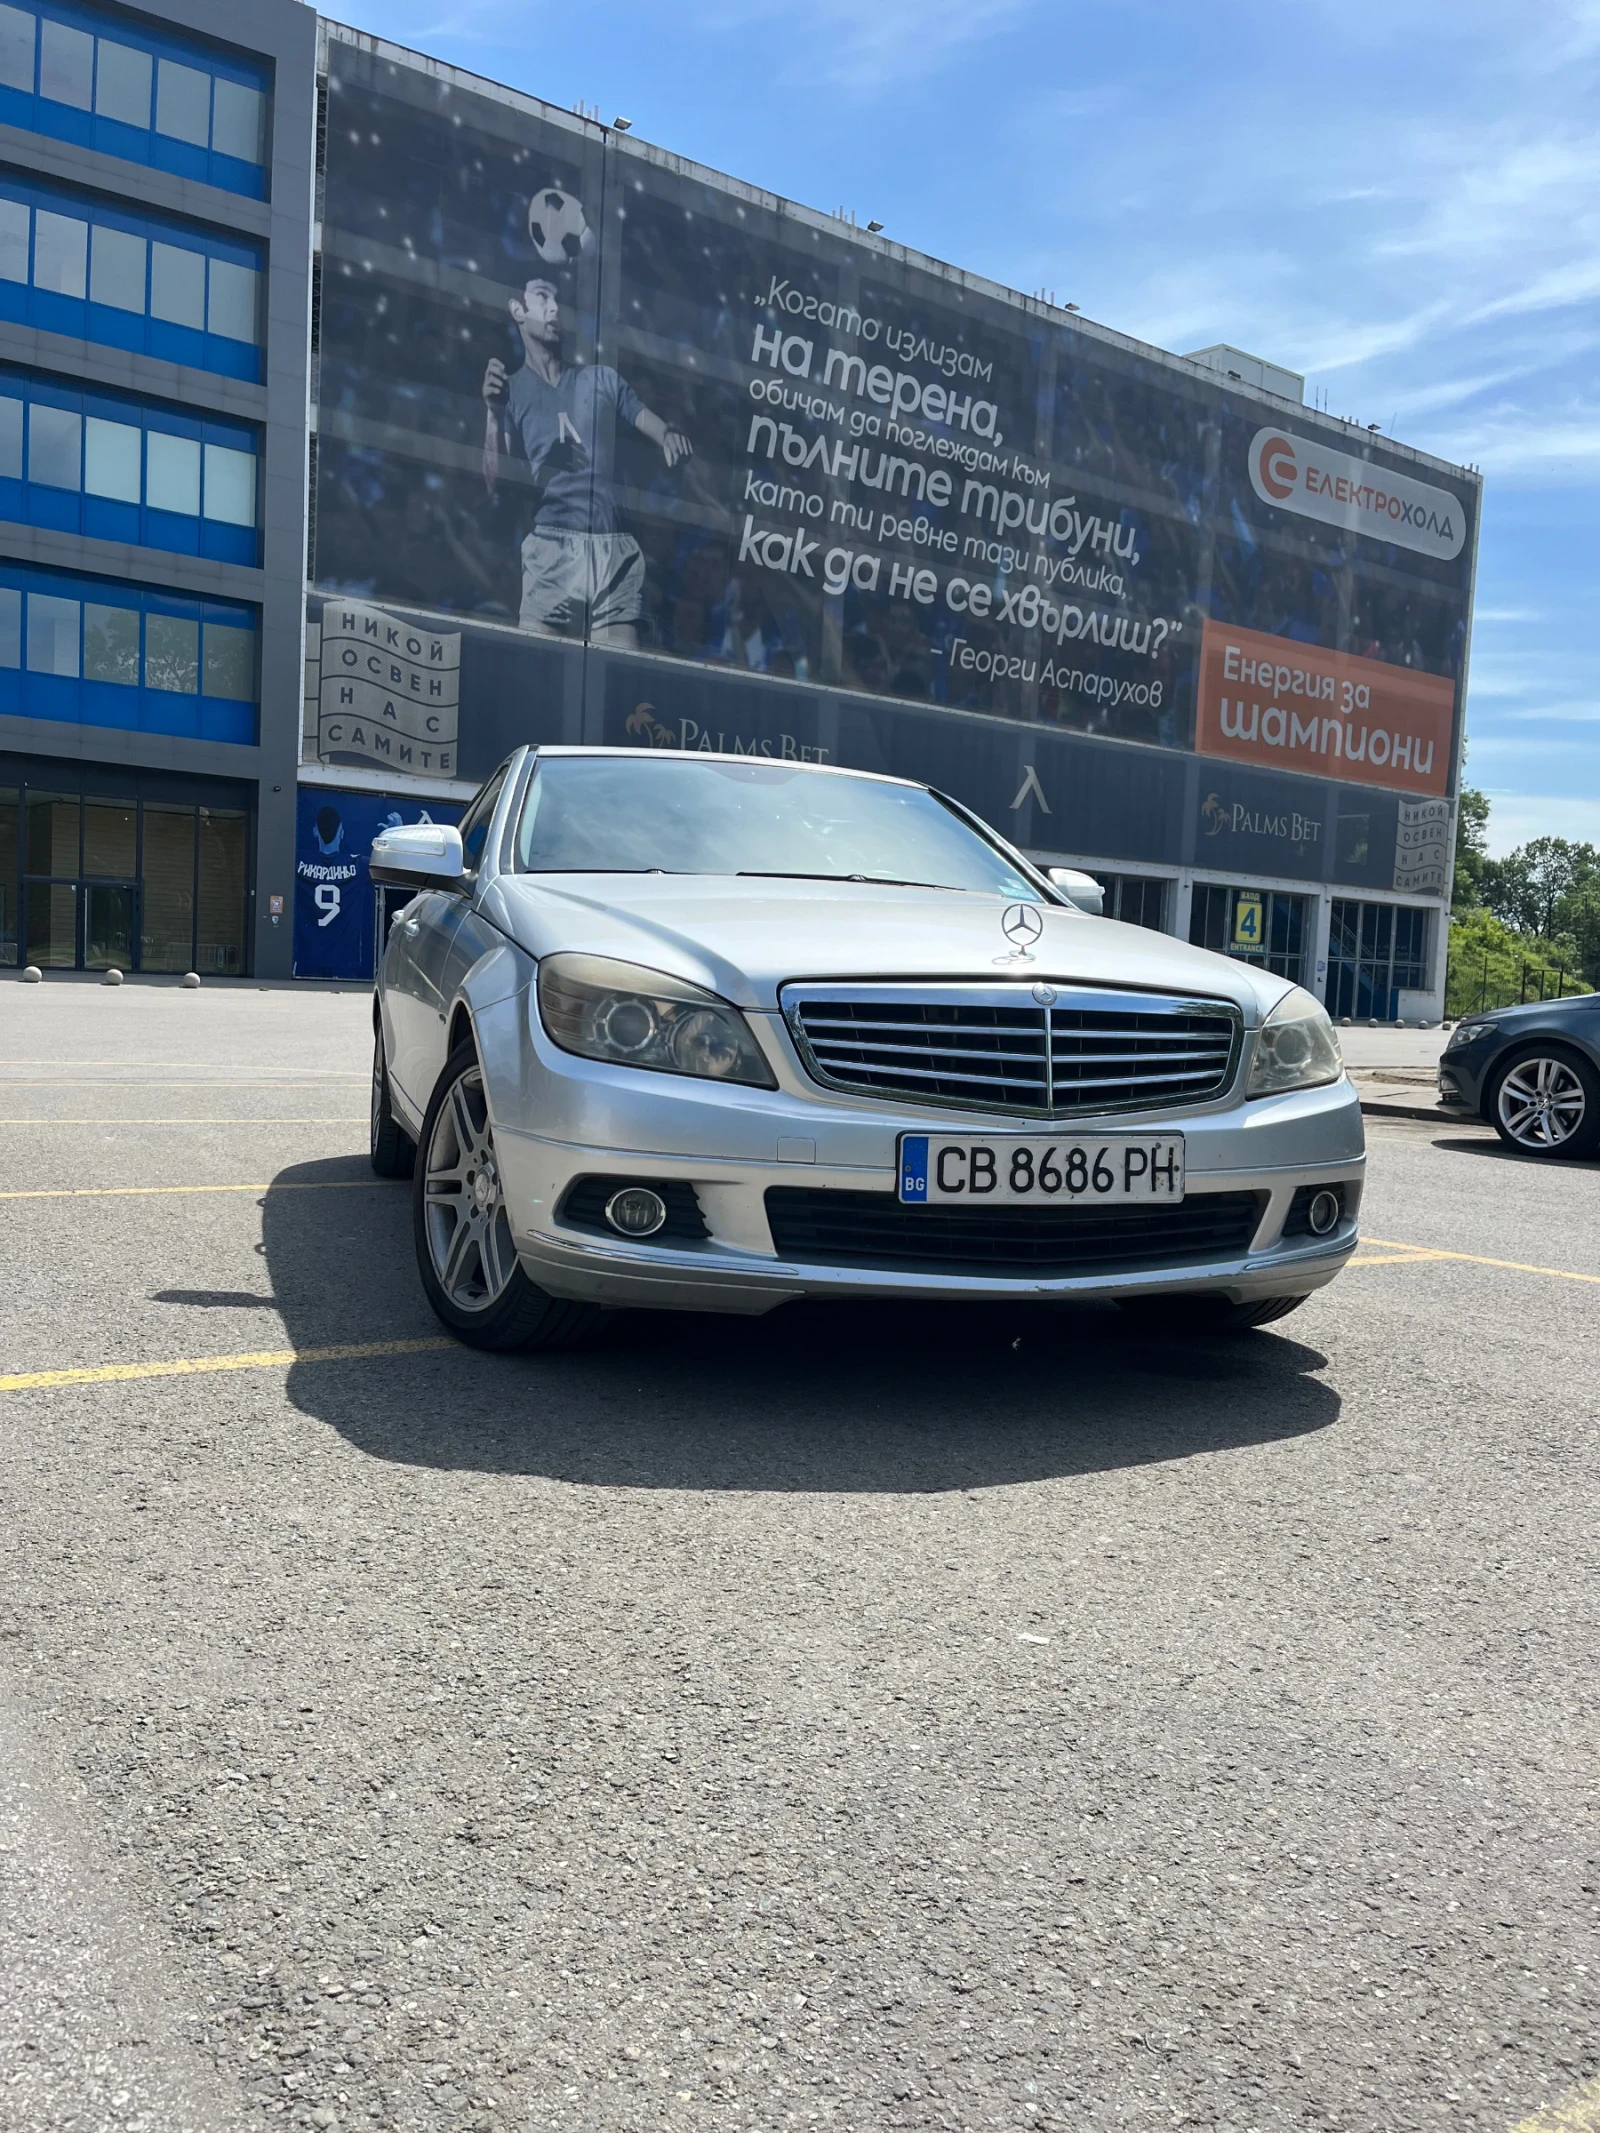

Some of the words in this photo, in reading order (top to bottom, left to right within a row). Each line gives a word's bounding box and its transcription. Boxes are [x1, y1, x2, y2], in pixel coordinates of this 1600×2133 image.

[887, 325, 993, 383] излизам
[751, 324, 813, 377] на
[823, 349, 1003, 447] терена,
[750, 379, 844, 425] обичам
[850, 412, 881, 437] да
[887, 420, 1008, 475] поглеждам
[1012, 456, 1050, 489] към
[746, 414, 953, 507] пълните
[961, 478, 1140, 565] трибуни,
[1305, 466, 1454, 541] ЕЛЕКТРОХОЛД
[744, 469, 824, 517] като
[831, 500, 873, 531] ти
[879, 511, 958, 552] ревне
[964, 535, 1039, 574] тази
[1035, 554, 1127, 599] публика,
[739, 514, 820, 578] как
[823, 546, 881, 595] да
[889, 564, 938, 604] не
[946, 577, 993, 617] се
[342, 612, 443, 661] НИКОЙ
[341, 649, 442, 697] ОСВЕН
[949, 637, 1036, 683] Георги
[1040, 658, 1163, 708] Аспарухов
[1223, 645, 1335, 700] Енергия
[1340, 680, 1370, 714] за
[328, 724, 450, 770] САМИТЕ
[1220, 697, 1434, 774] шампиони
[1403, 828, 1442, 843] ОСВЕН
[1404, 804, 1443, 821] НИКОЙ
[297, 860, 357, 881] РИКАРДИНЬО
[1396, 871, 1442, 888] САМИТЕ
[314, 884, 341, 927] 9
[1241, 891, 1260, 902] ВХОД
[1240, 907, 1257, 938] 4
[1230, 943, 1265, 953] ENTRANCE
[905, 1177, 925, 1192] BG
[937, 1146, 998, 1193] CB
[1009, 1147, 1115, 1194] 8686
[1124, 1147, 1175, 1193] PH
